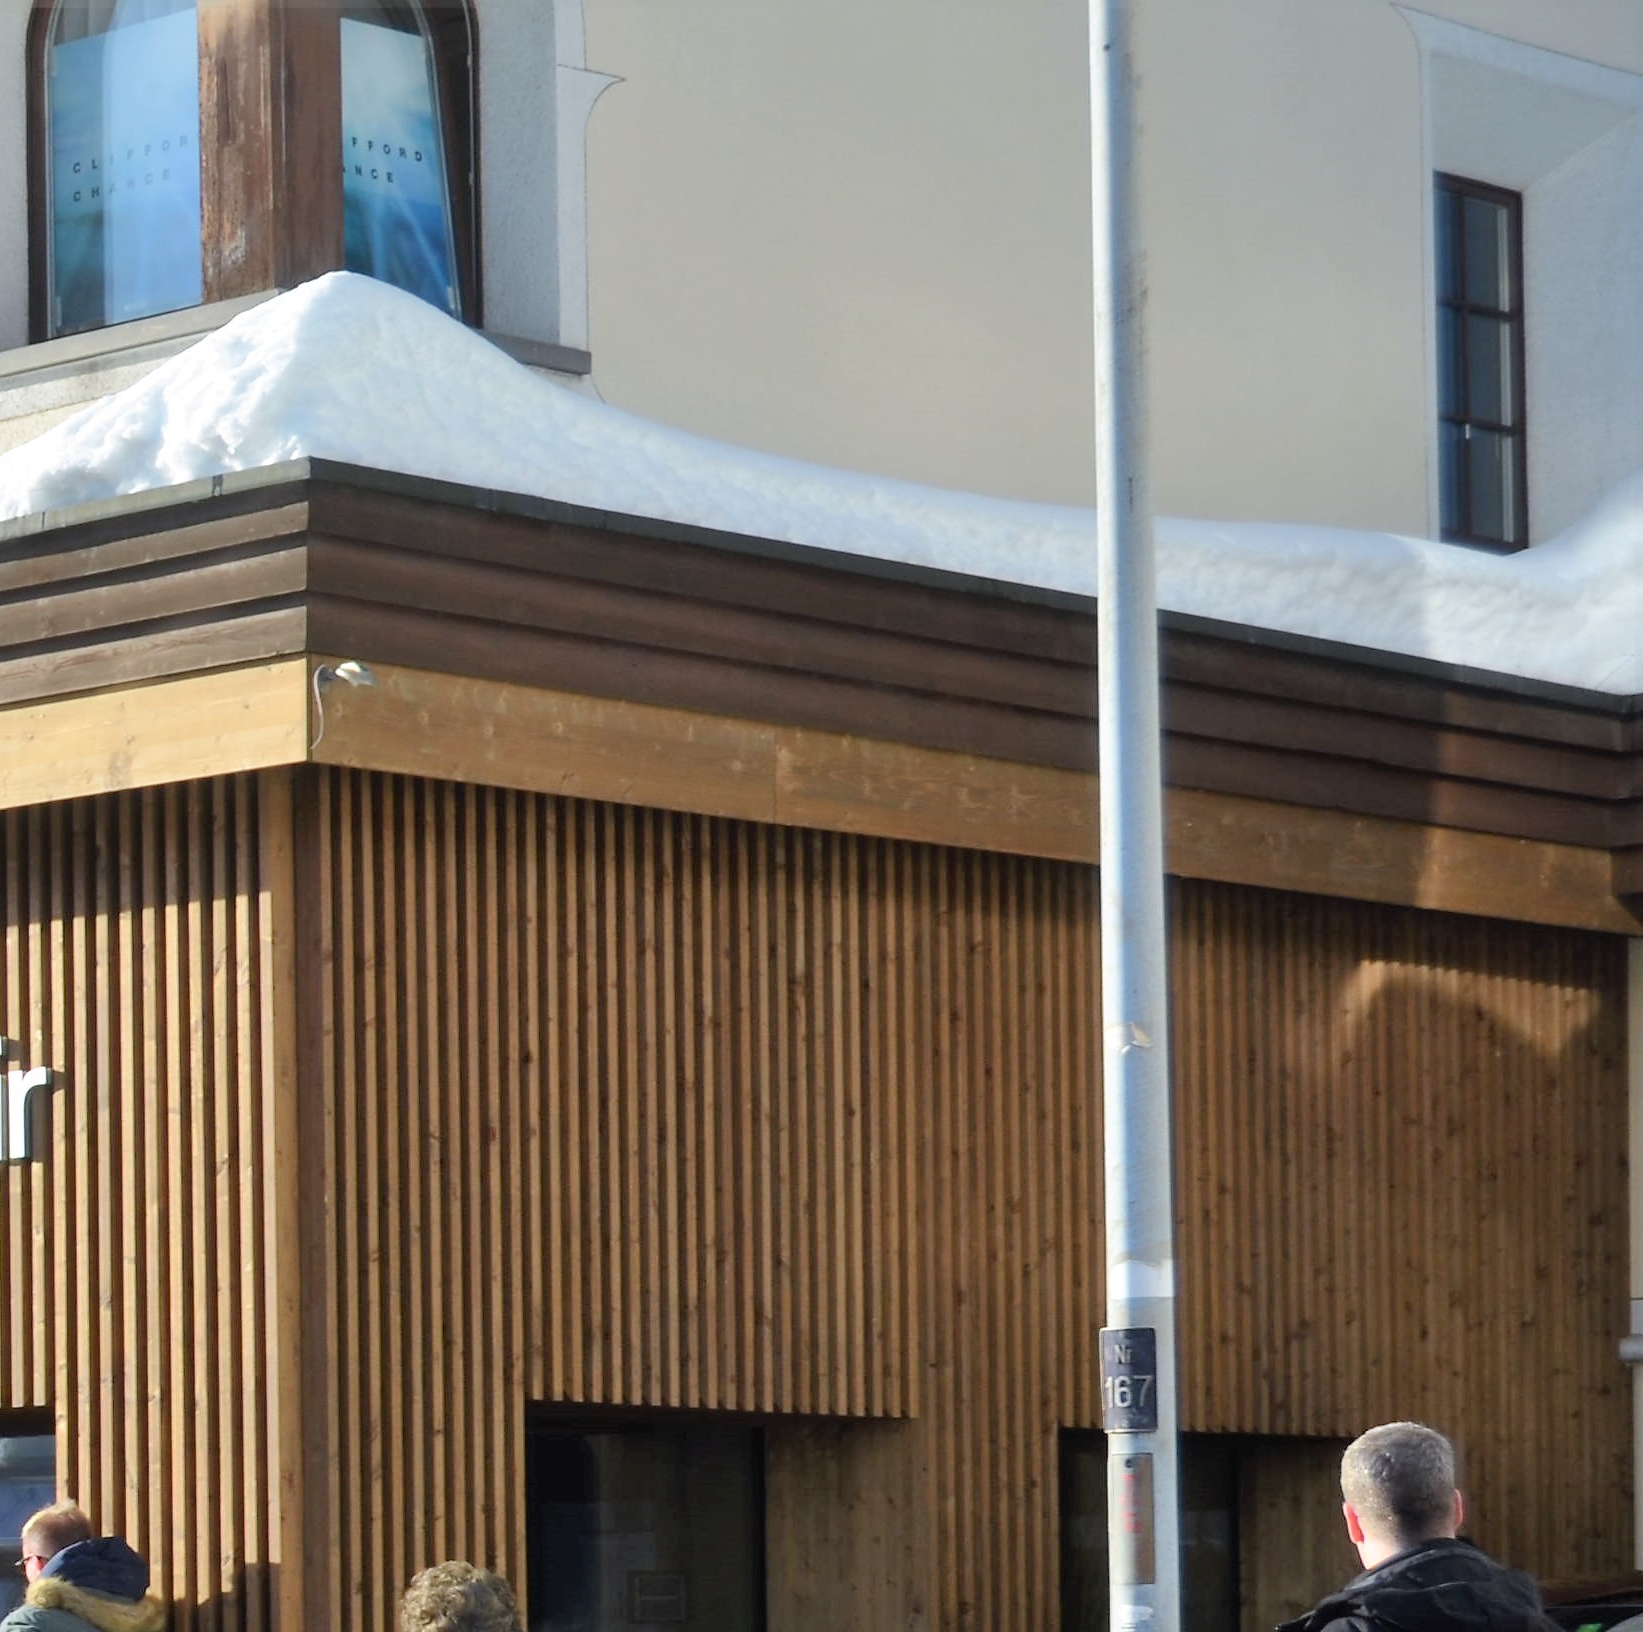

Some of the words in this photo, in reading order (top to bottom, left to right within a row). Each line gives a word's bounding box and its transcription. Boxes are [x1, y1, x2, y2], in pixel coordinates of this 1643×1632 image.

[73, 135, 188, 174] CLIFFOR
[351, 136, 423, 163] FFORD
[1105, 1375, 1153, 1408] 167
